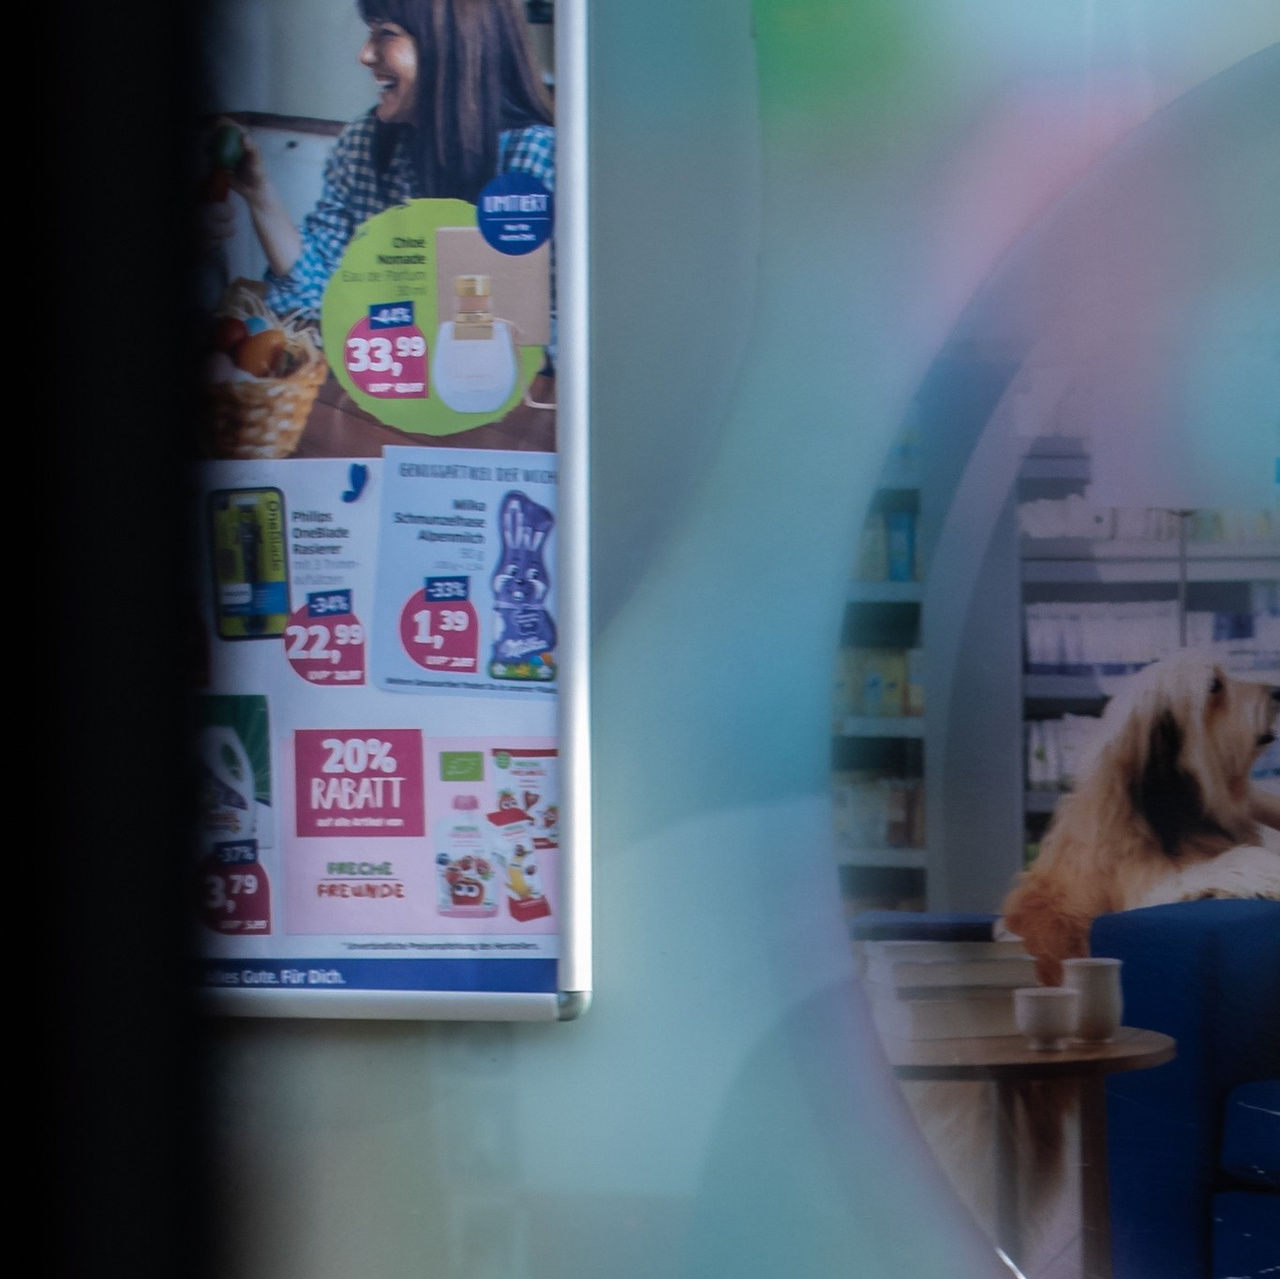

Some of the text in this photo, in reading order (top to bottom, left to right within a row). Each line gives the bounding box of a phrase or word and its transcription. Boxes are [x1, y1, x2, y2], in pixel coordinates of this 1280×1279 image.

[523, 466, 557, 485] WOCH
[292, 510, 334, 524] Philips
[292, 526, 350, 540] OneBlade
[413, 610, 469, 649] 1,39
[285, 623, 365, 664] 22,99
[321, 738, 397, 774] 20%
[310, 776, 407, 810] RABATT
[327, 860, 394, 876] FRECHE
[317, 882, 406, 898] FREUNDE
[243, 969, 280, 986] Gute.
[281, 968, 305, 985] Für
[308, 968, 346, 985] Dich.
